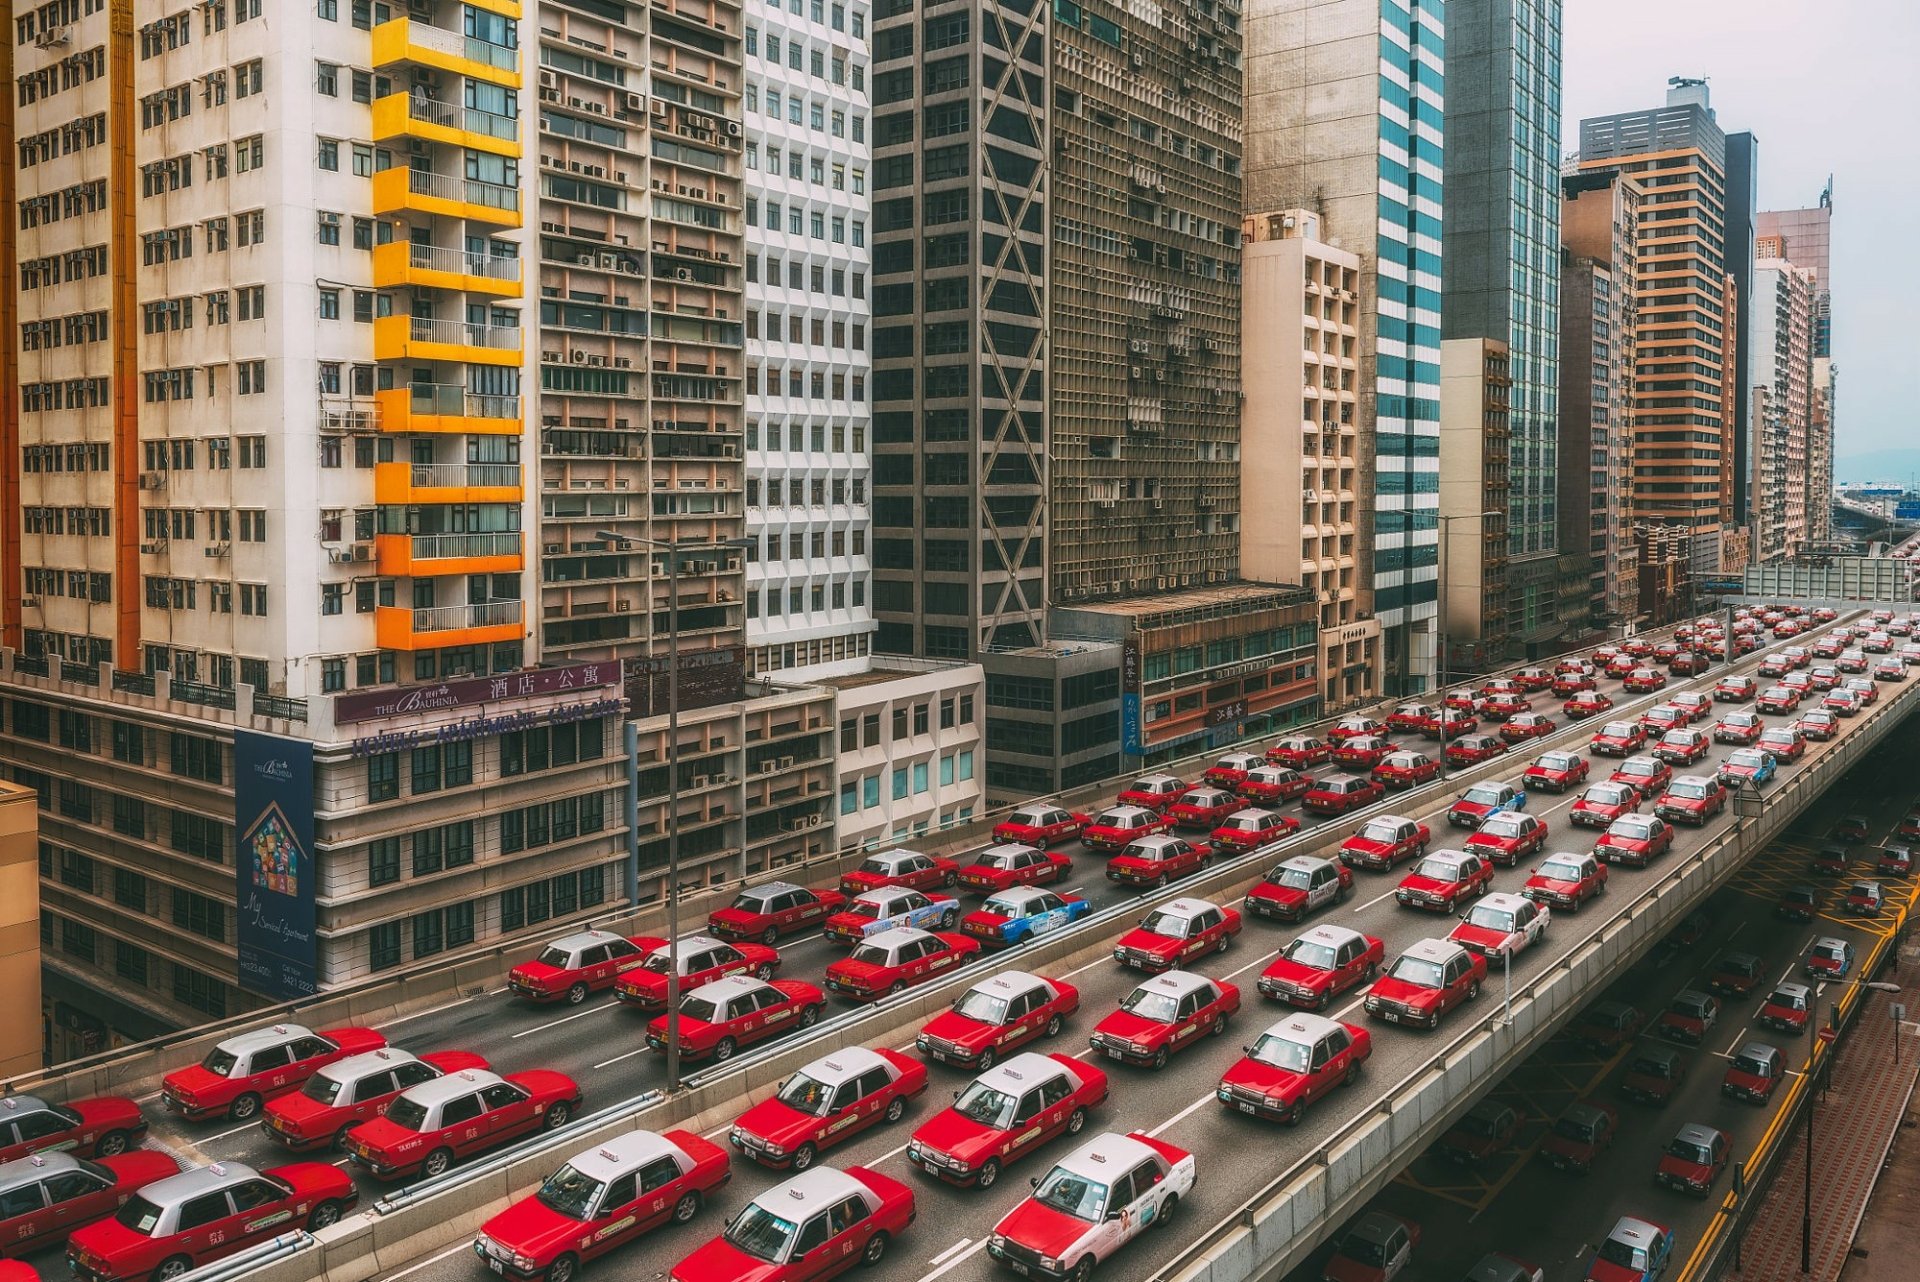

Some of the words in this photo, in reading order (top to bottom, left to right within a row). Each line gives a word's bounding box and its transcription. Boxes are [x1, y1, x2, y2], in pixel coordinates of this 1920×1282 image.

[375, 704, 395, 715] THE
[396, 687, 459, 713] BAUHINIA
[352, 729, 420, 758] HOTELS
[243, 892, 262, 925] My
[397, 1142, 411, 1152] TAXI
[210, 1235, 225, 1246] TAXI
